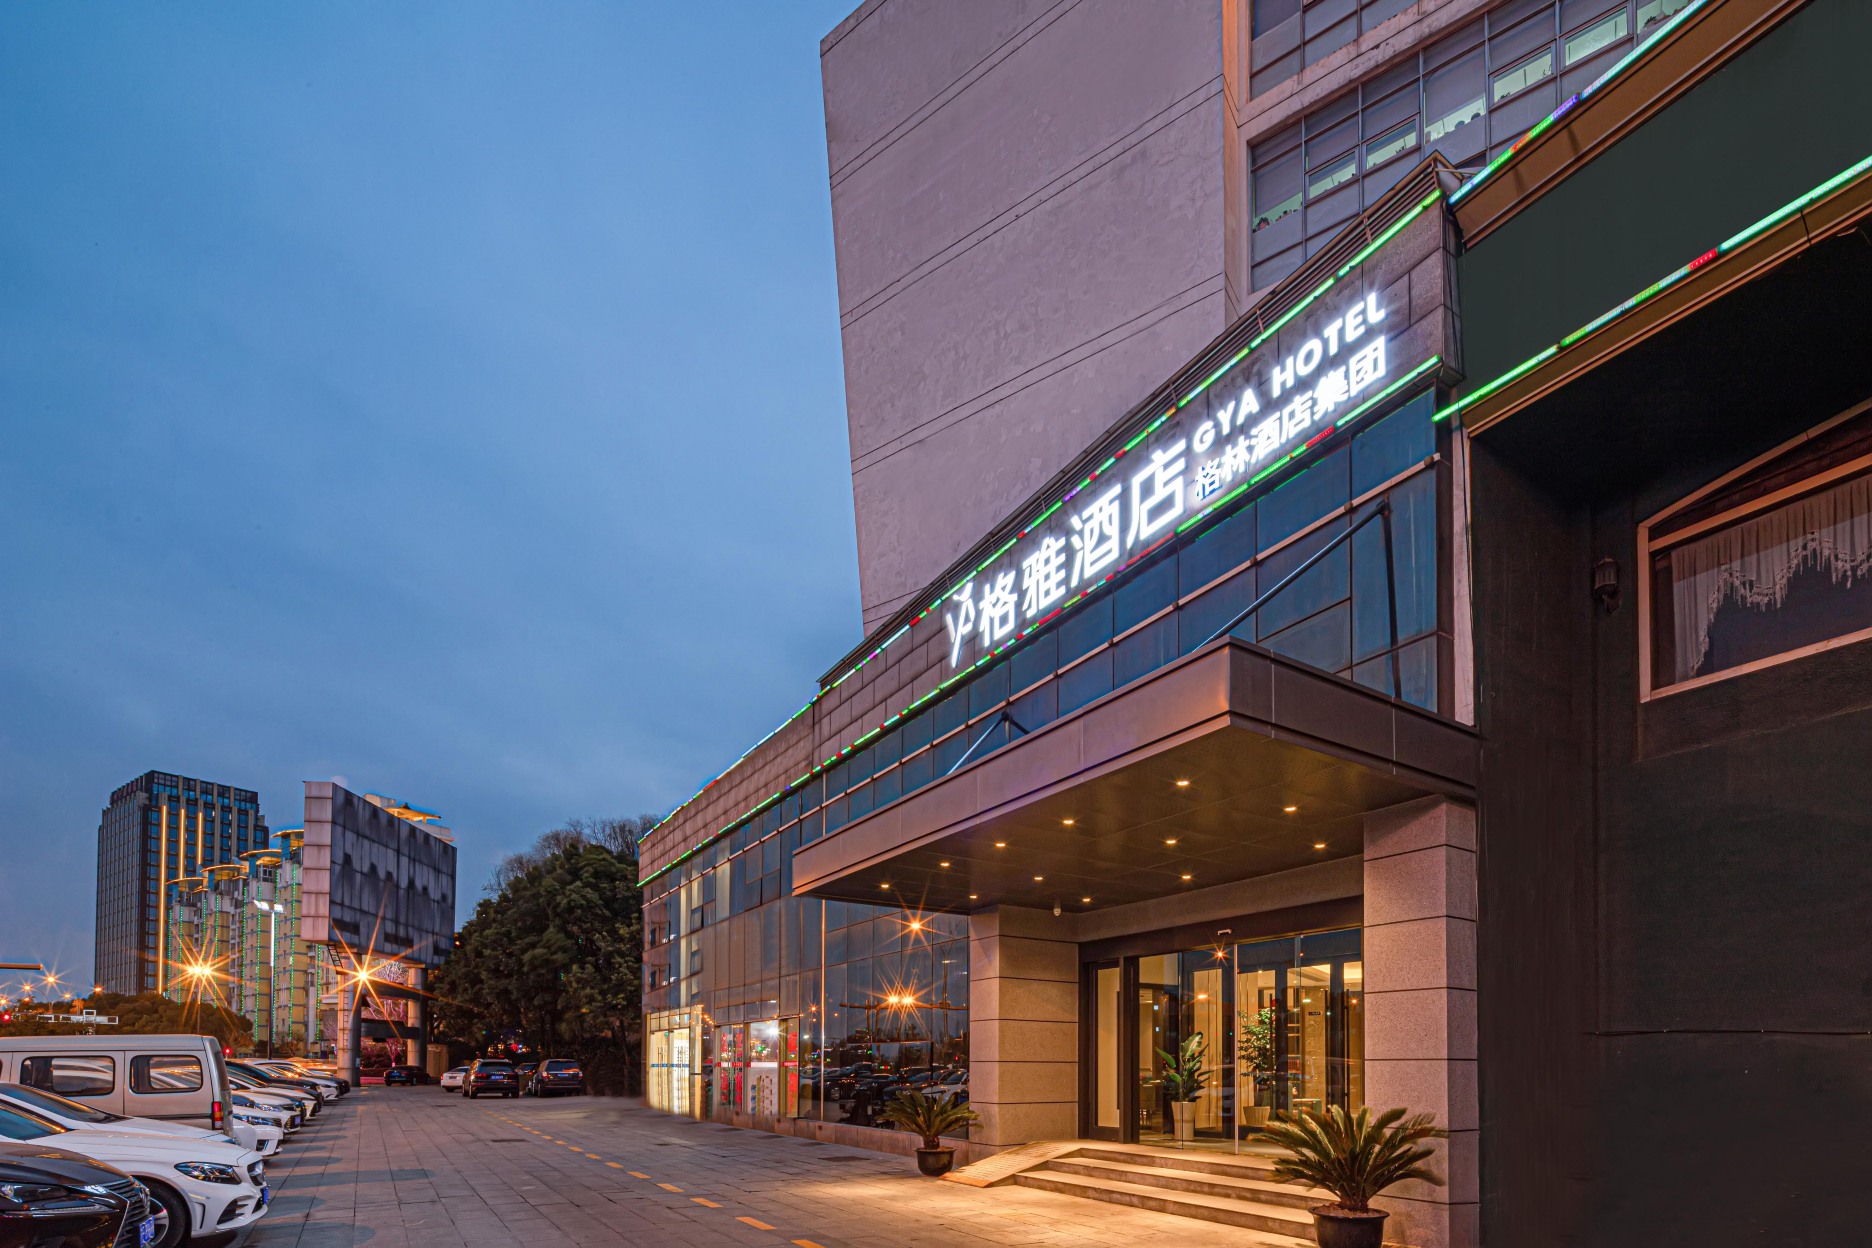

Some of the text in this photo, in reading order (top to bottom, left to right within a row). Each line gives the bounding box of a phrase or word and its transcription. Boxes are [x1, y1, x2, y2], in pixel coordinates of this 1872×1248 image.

[1194, 292, 1385, 452] GYA HOTEL
[1195, 336, 1386, 500] 格林酒店集团
[980, 439, 1186, 647] 格雅酒店
